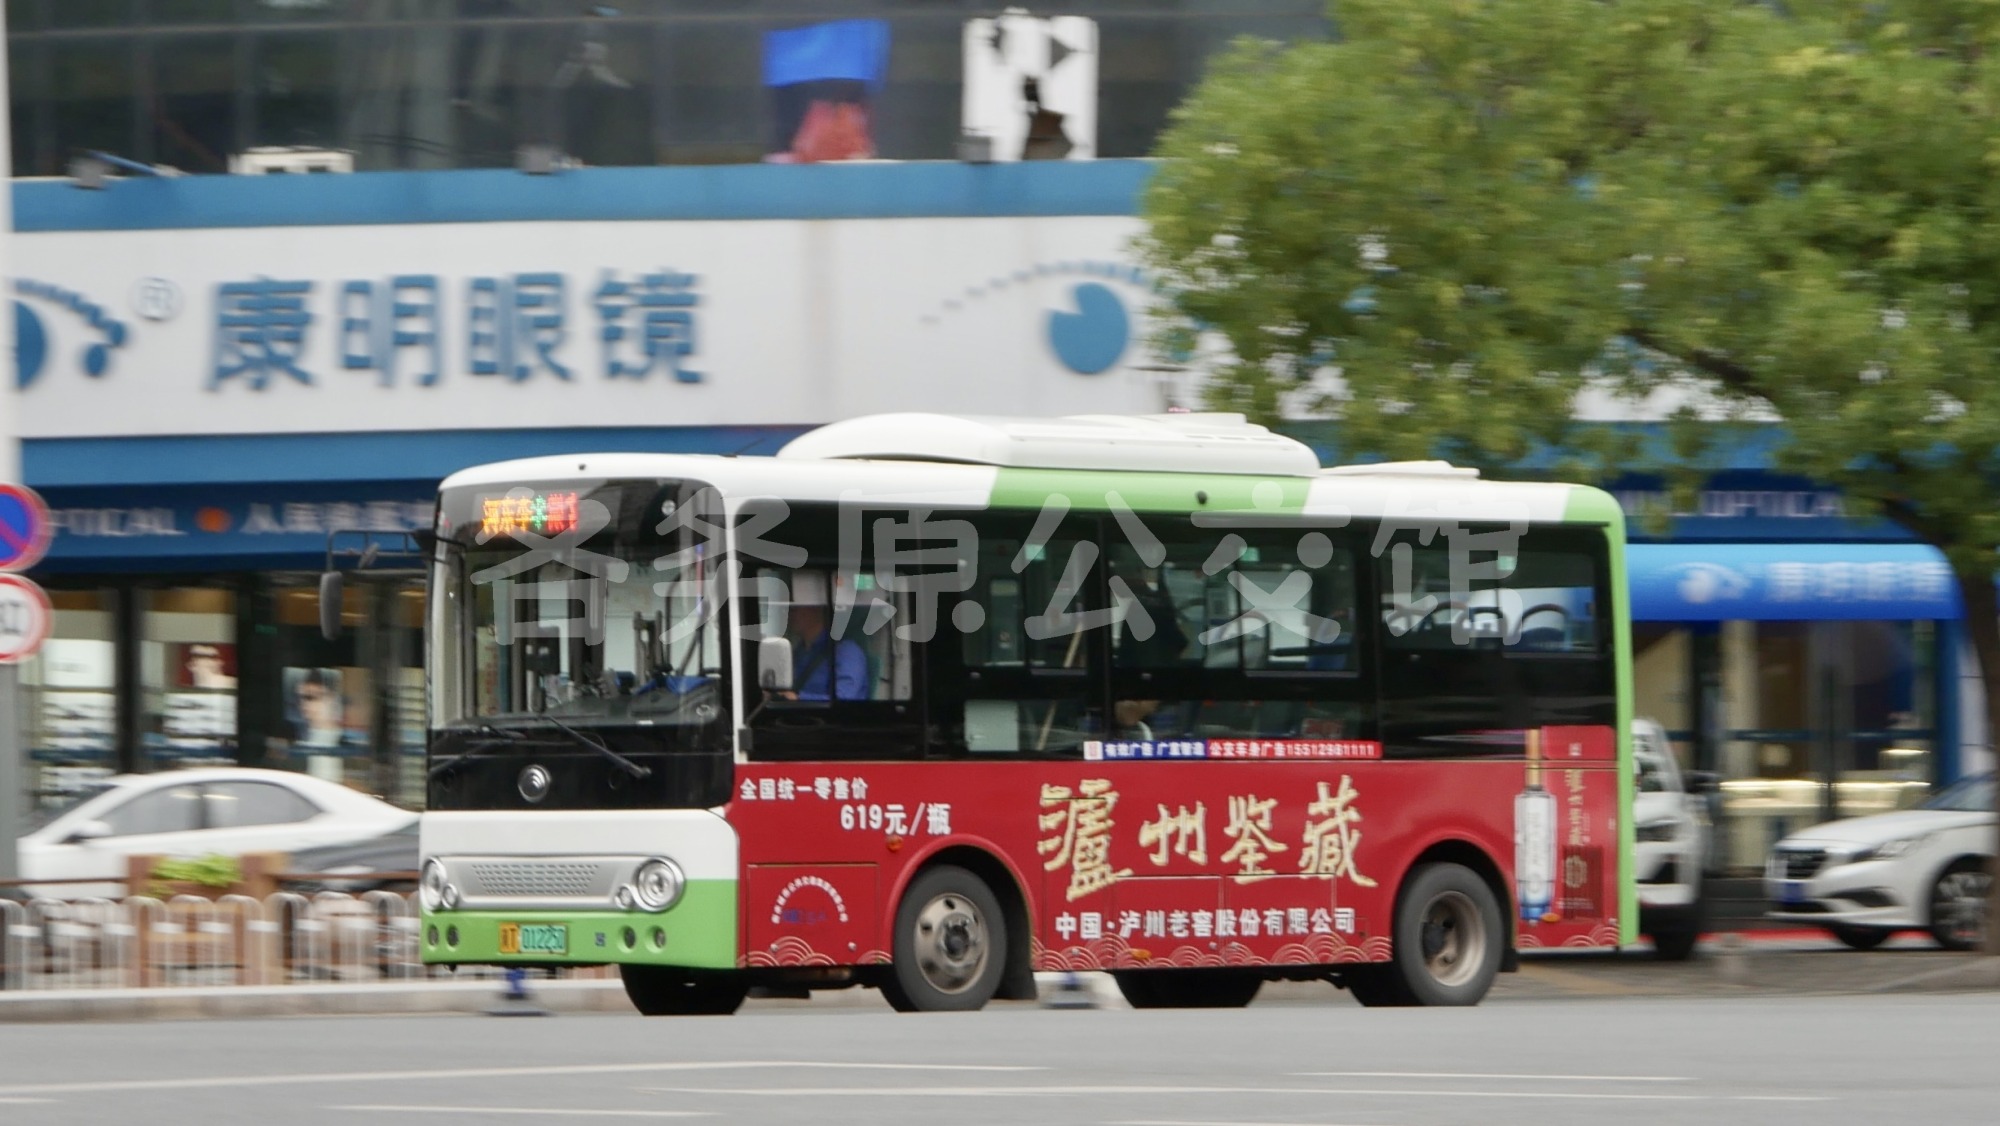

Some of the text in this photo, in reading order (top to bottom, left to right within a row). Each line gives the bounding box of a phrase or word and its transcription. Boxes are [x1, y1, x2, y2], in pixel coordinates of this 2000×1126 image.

[208, 270, 707, 391] 康明眼镜
[740, 777, 868, 801] 全国统一零售价
[841, 801, 951, 836] 619元/瓶
